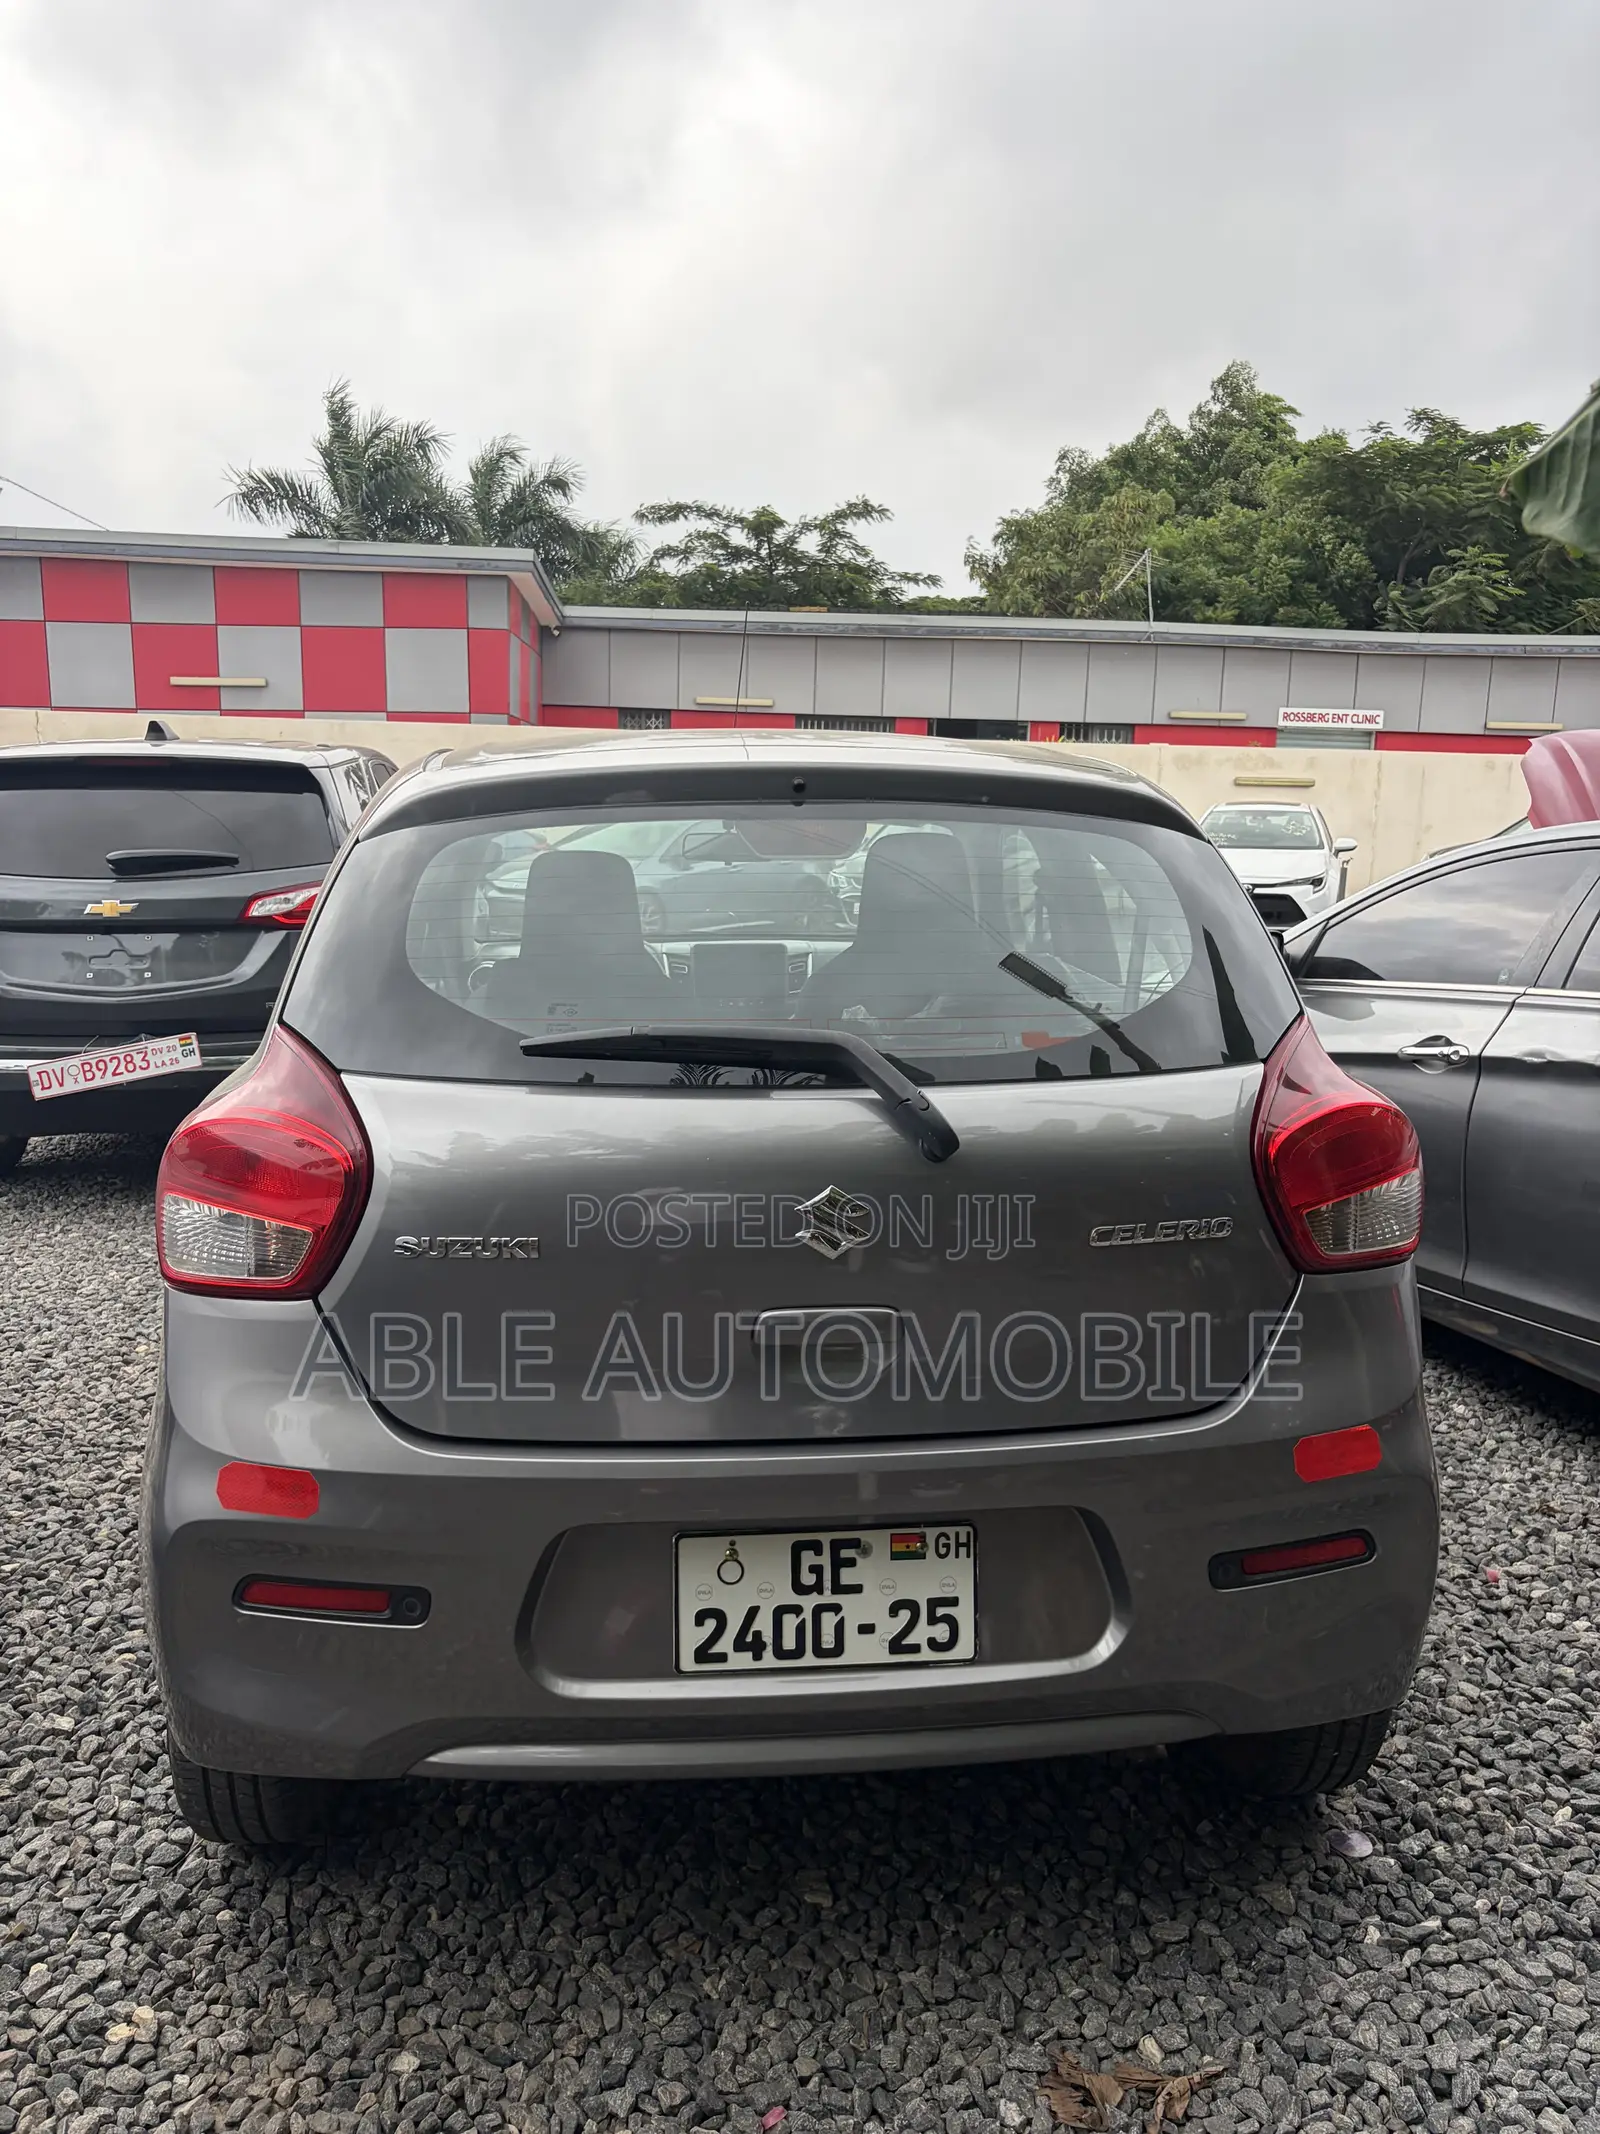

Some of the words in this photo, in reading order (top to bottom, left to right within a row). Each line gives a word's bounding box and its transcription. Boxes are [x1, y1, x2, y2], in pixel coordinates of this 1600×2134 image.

[1282, 712, 1329, 723] ROSSBERG
[1331, 713, 1349, 724] ENT
[1351, 714, 1380, 724] CLINIC
[151, 1046, 163, 1056] DV
[181, 1047, 196, 1058] GH
[37, 1067, 65, 1091] DV
[80, 1051, 150, 1082] B9283
[153, 1060, 167, 1068] LA
[1089, 1216, 1234, 1247] CELERIO
[393, 1235, 540, 1259] SUZUKI
[934, 1531, 971, 1560] GH
[790, 1537, 864, 1596] GE
